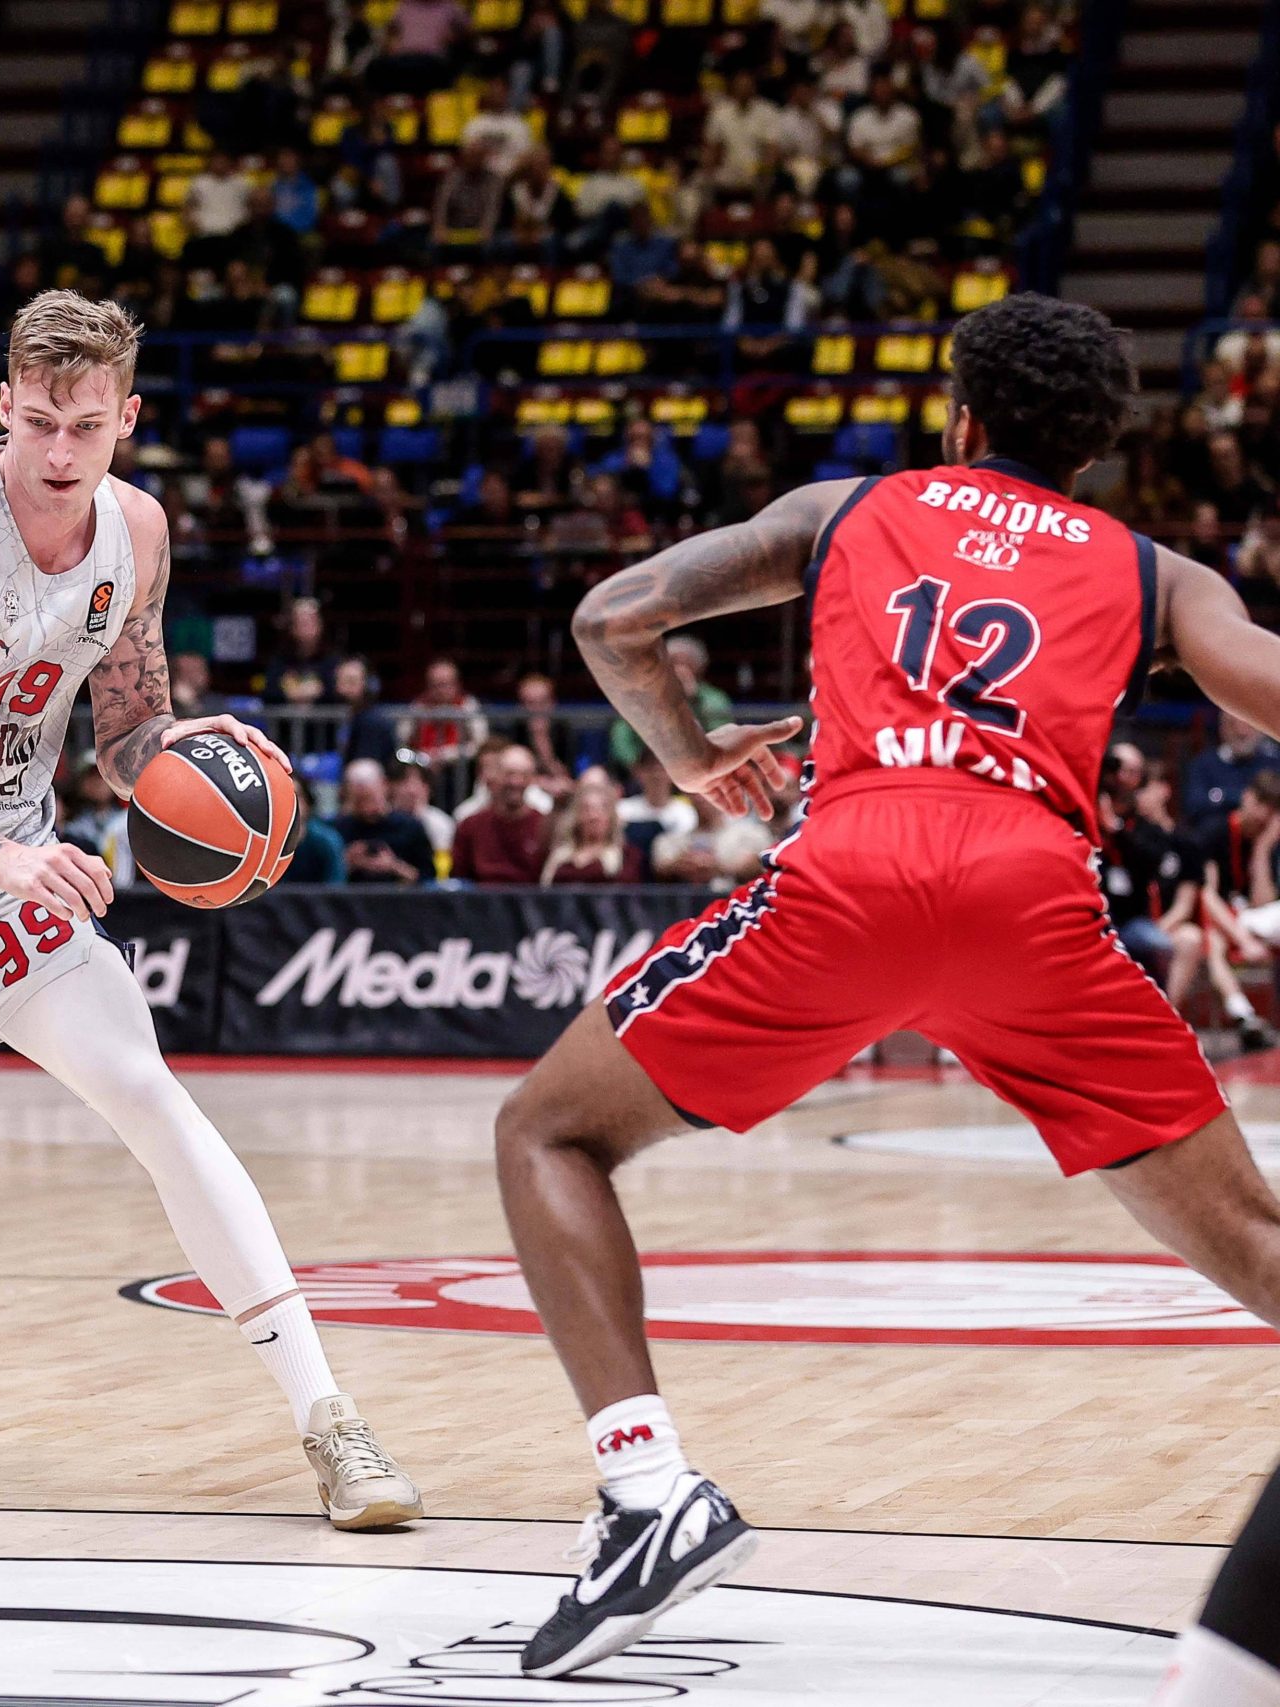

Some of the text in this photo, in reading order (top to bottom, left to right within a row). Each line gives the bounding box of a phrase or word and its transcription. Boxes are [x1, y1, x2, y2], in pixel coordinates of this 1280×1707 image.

[916, 481, 1092, 543] BROOKS
[885, 573, 1042, 738] 12
[257, 928, 515, 1009] Media
